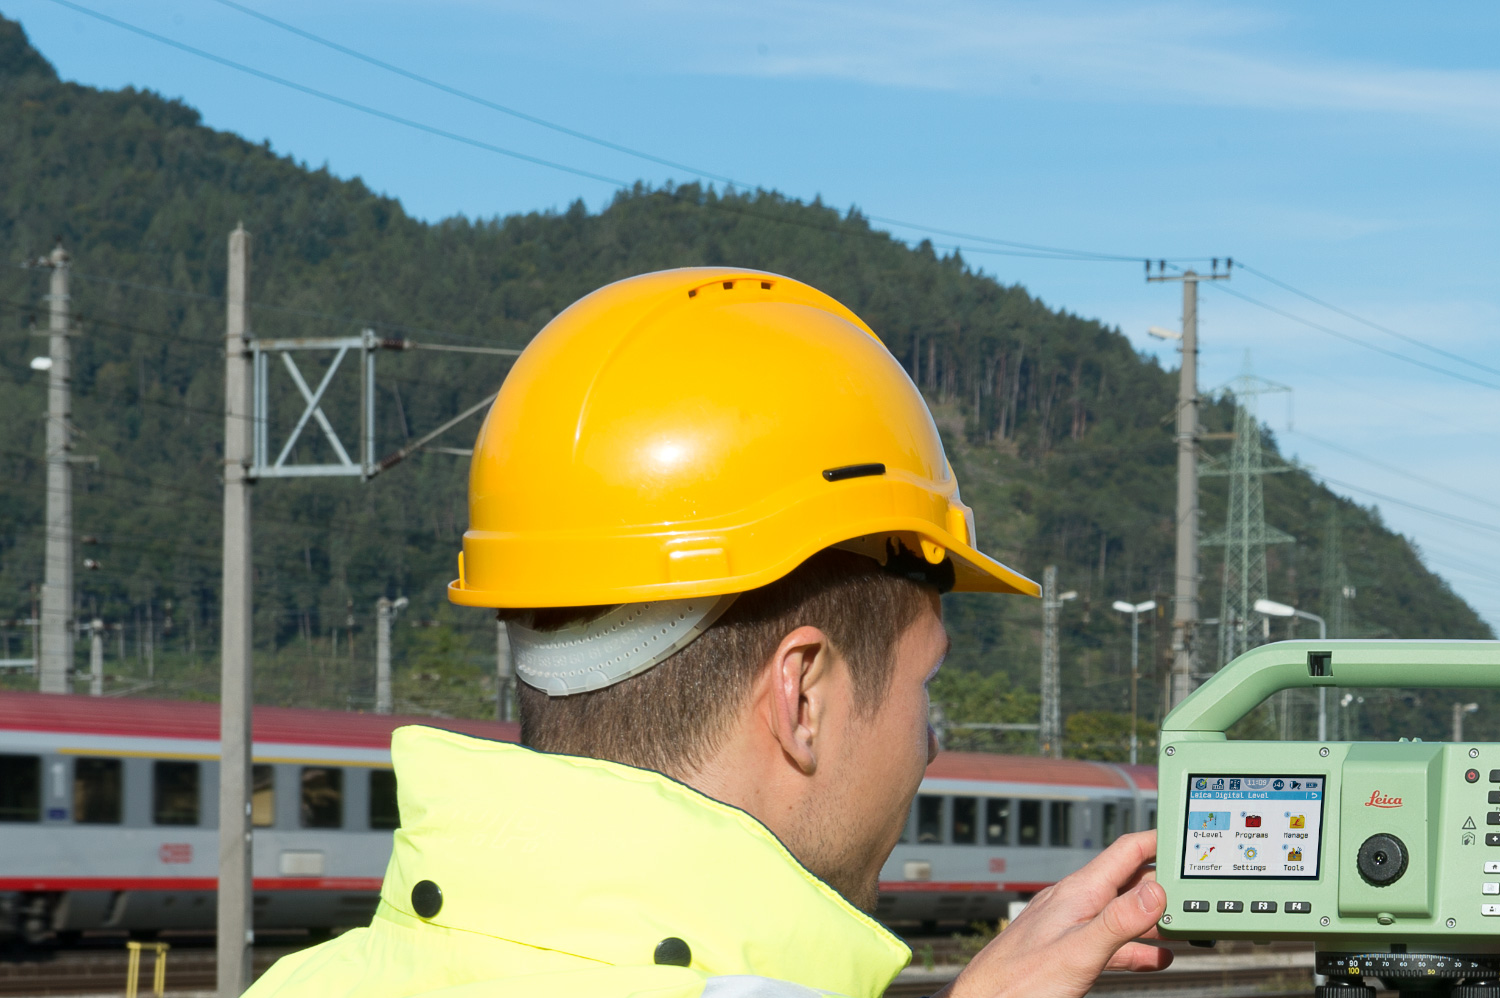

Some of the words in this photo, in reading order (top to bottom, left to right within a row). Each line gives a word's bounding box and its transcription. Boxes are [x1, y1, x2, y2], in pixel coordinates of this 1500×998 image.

[1190, 791, 1212, 799] Leica
[1215, 791, 1245, 800] Digital
[1247, 791, 1269, 799] Level
[1364, 790, 1403, 808] Leica
[1235, 831, 1269, 839] Programs
[1233, 864, 1267, 872] Settings
[1258, 902, 1268, 910] F3
[1348, 967, 1360, 975] 100
